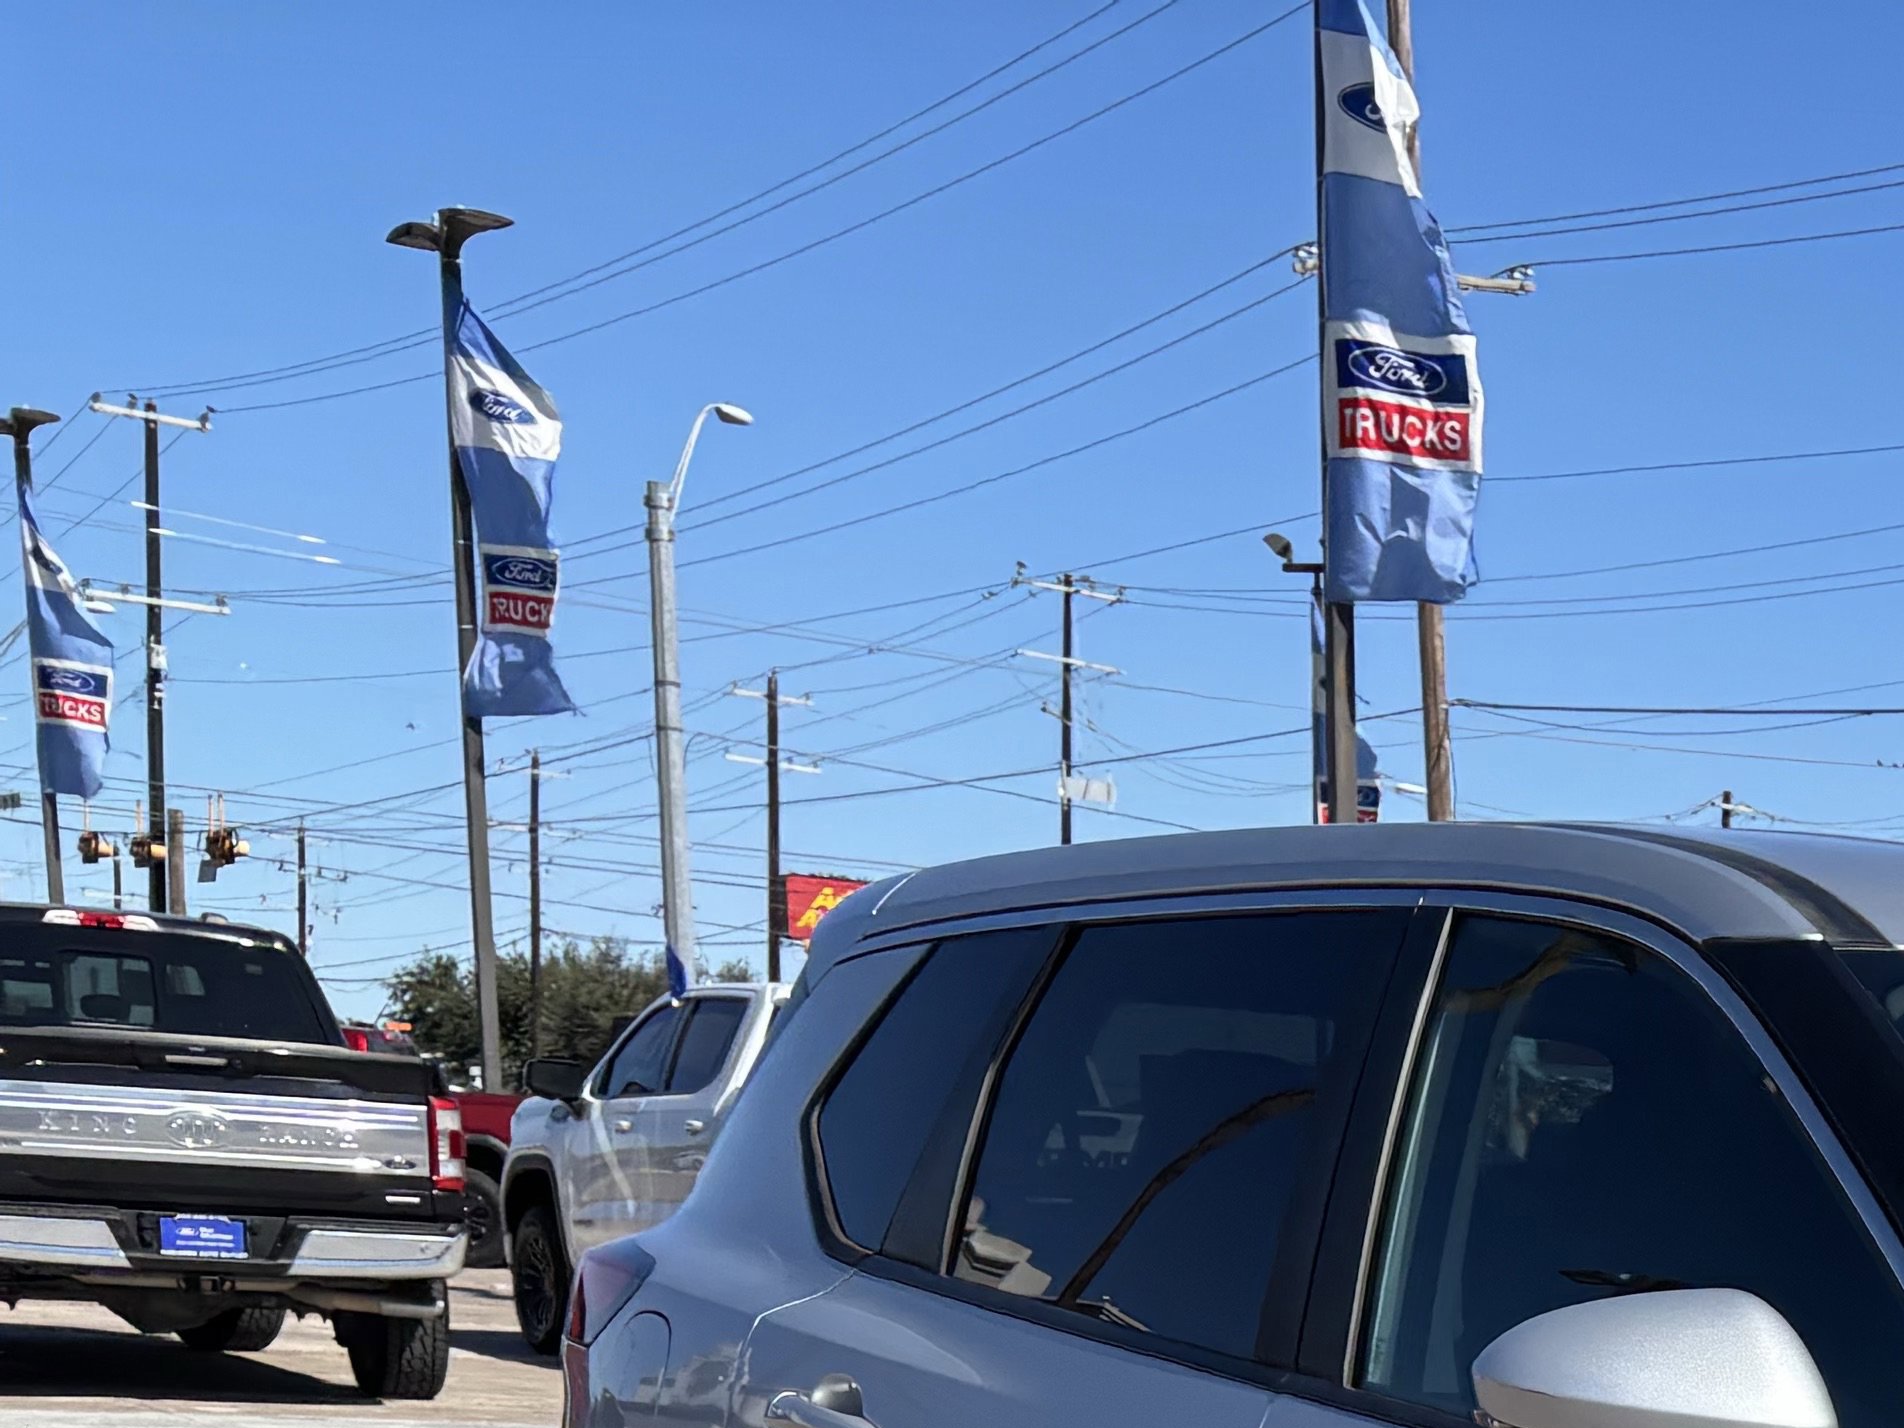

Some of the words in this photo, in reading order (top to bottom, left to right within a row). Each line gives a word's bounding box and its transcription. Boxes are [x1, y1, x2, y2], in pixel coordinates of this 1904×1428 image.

[1368, 353, 1429, 388] Ford
[1344, 406, 1463, 452] TRUCKS
[504, 562, 543, 582] Ford
